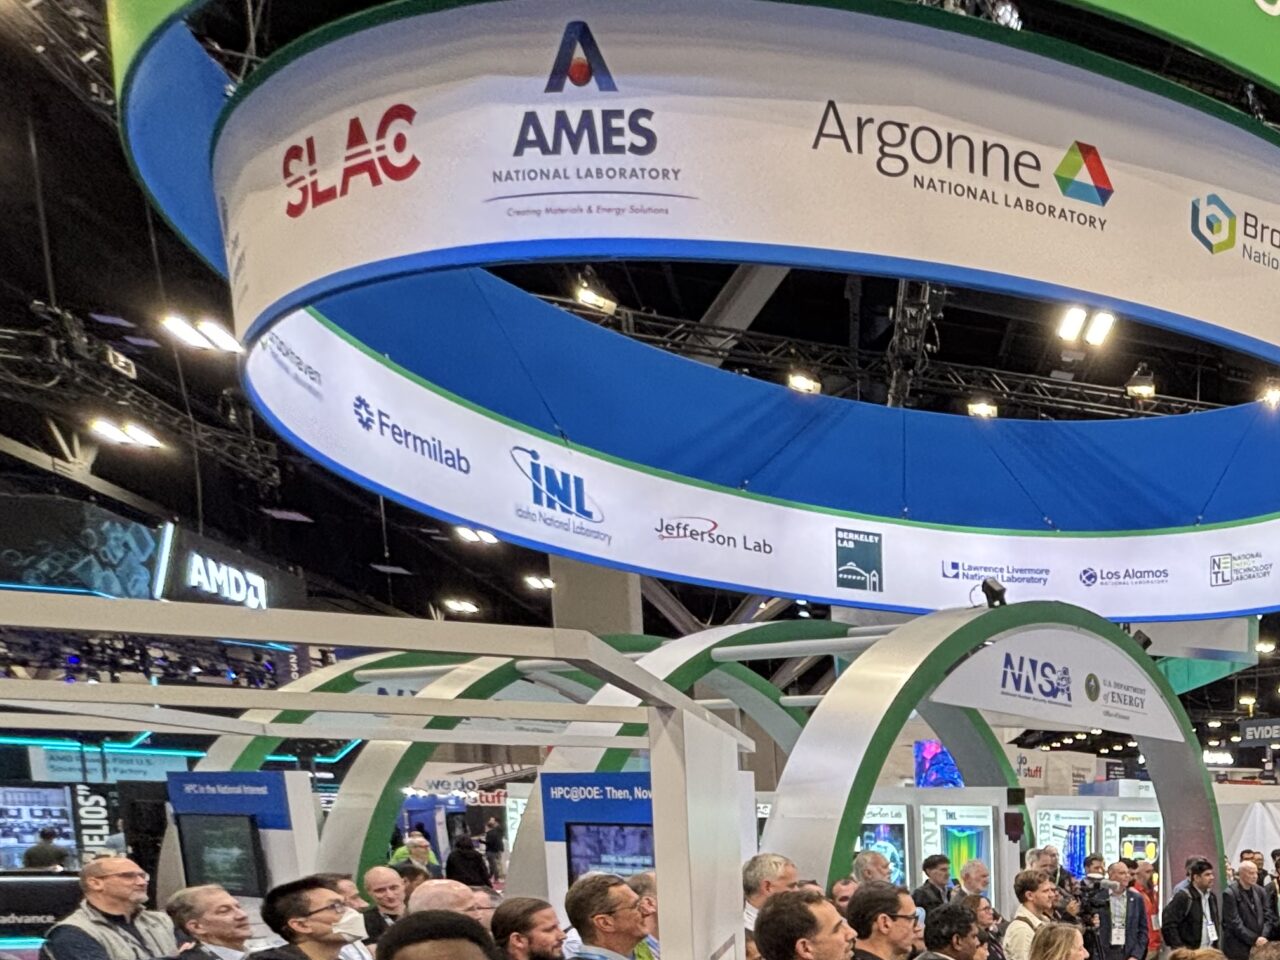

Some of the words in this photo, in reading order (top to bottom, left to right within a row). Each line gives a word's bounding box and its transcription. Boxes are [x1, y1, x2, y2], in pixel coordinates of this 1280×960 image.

[513, 108, 658, 157] AMES
[811, 99, 1042, 188] Argonne
[283, 104, 421, 218] SLAC
[493, 167, 571, 183] NATIONAL
[576, 166, 681, 181] LABORATORY
[913, 173, 999, 206] NATIONAL
[1004, 194, 1107, 232] LABORATORY
[507, 207, 542, 218] Creating
[596, 204, 626, 216] Energy
[629, 204, 670, 215] Solutions
[377, 408, 471, 475] Fermilab
[655, 517, 737, 549] Jefferson
[743, 535, 773, 555] Lab
[837, 530, 880, 544] BERKELEY
[837, 539, 855, 549] LAB
[1232, 552, 1263, 562] NATIONAL
[962, 562, 1005, 574] Lawrence
[1006, 564, 1050, 576] Livermore
[1100, 569, 1121, 581] Los
[1123, 567, 1169, 580] Alamos
[1233, 563, 1273, 575] TECHNOLOGY
[1001, 574, 1048, 587] Laboratory
[1232, 571, 1271, 583] LABORATORY
[1001, 652, 1073, 702] NNSA
[1113, 683, 1147, 696] DEPARTMENT
[1111, 691, 1146, 709] ENERGY
[217, 785, 241, 794] National
[242, 785, 268, 795] Interest
[550, 786, 604, 802] HPC@DOE:
[606, 786, 633, 802] Then,
